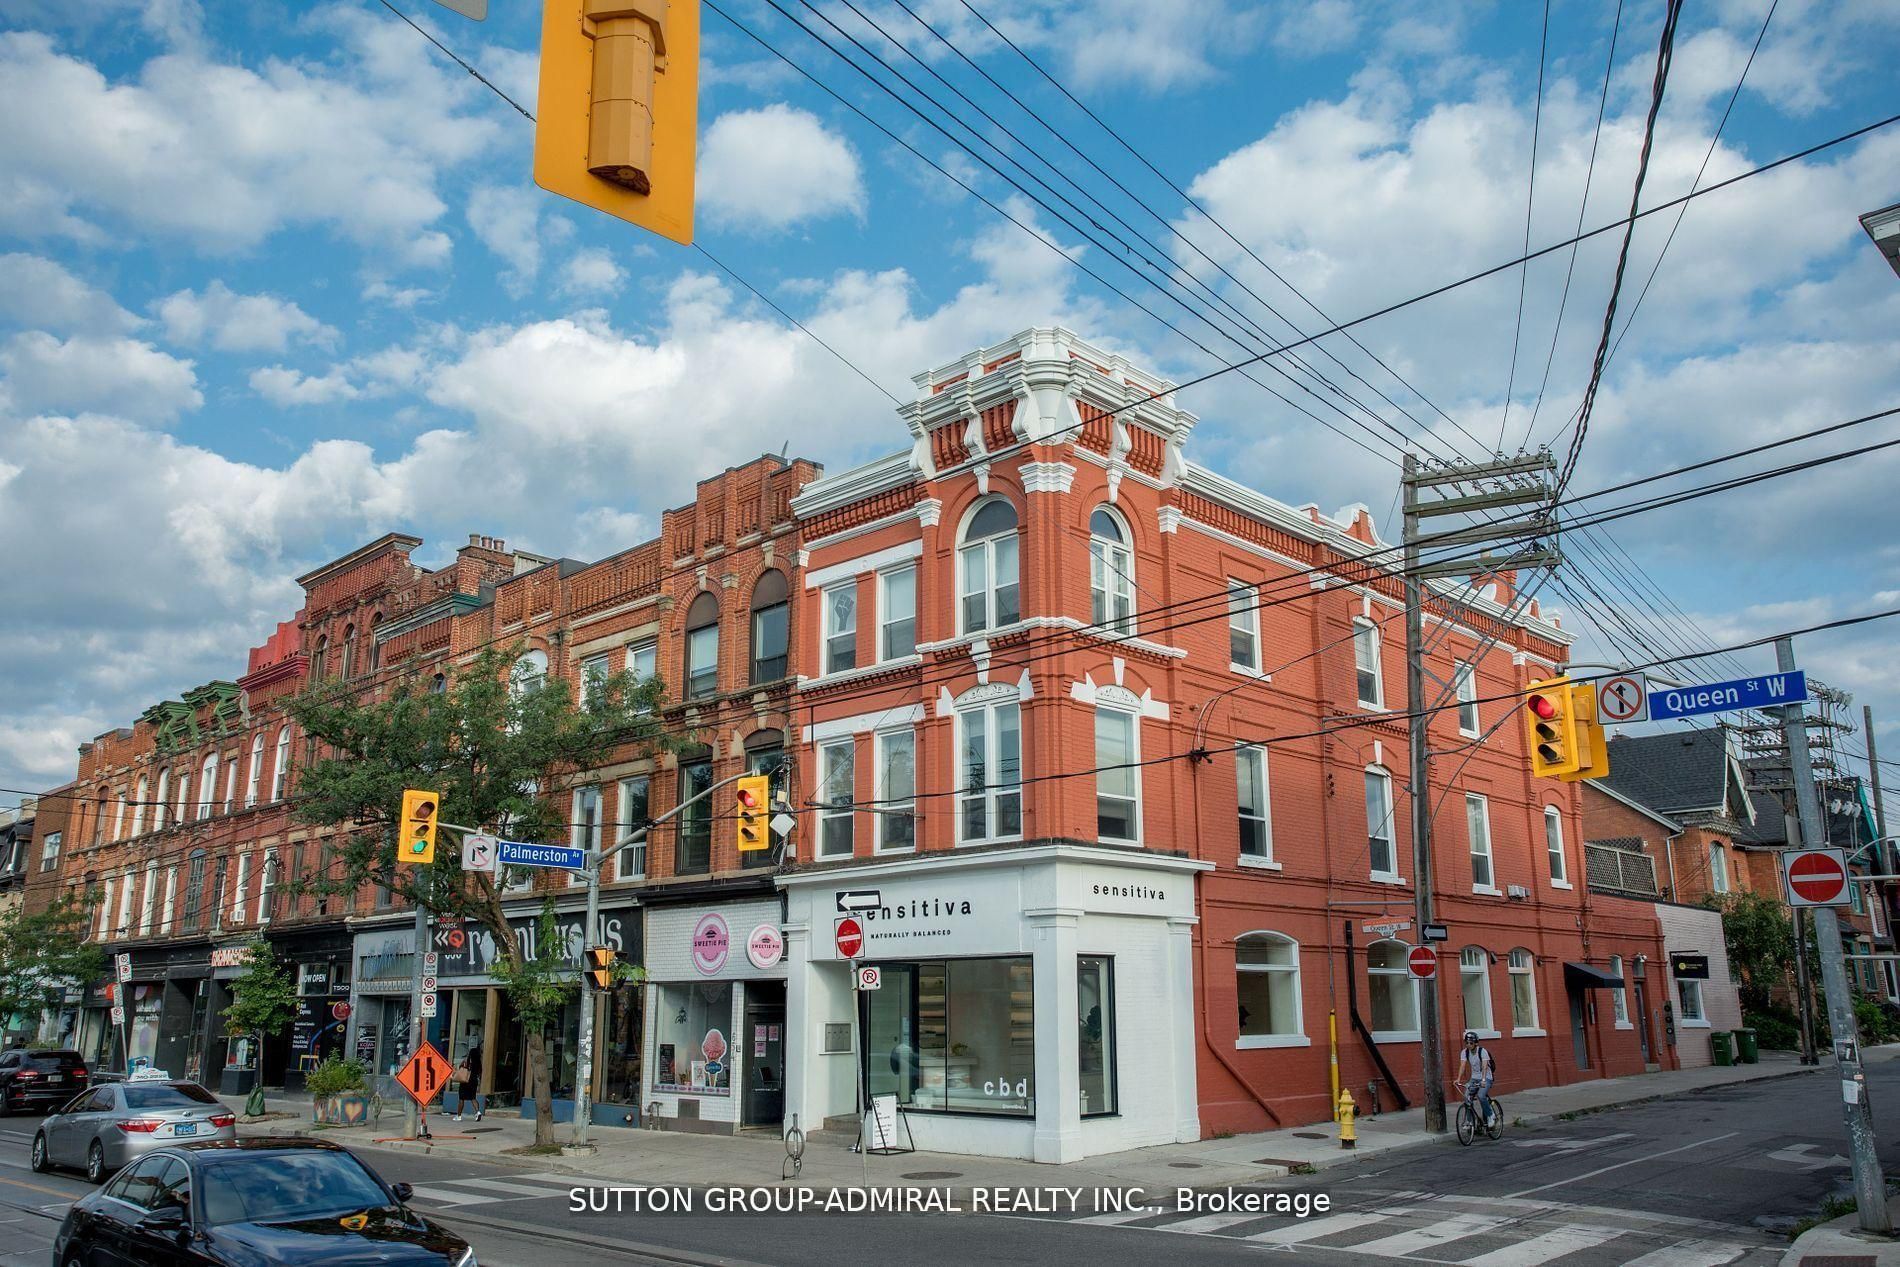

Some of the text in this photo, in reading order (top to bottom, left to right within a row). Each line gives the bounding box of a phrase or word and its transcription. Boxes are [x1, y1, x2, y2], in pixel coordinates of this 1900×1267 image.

[1666, 676, 1785, 712] Queen St W
[503, 844, 568, 863] Palmerston
[1093, 884, 1165, 900] sensitiva
[852, 898, 971, 920] ensitiva
[870, 929, 951, 939] NATURALLY BALANCED
[984, 1076, 1027, 1097] cbd
